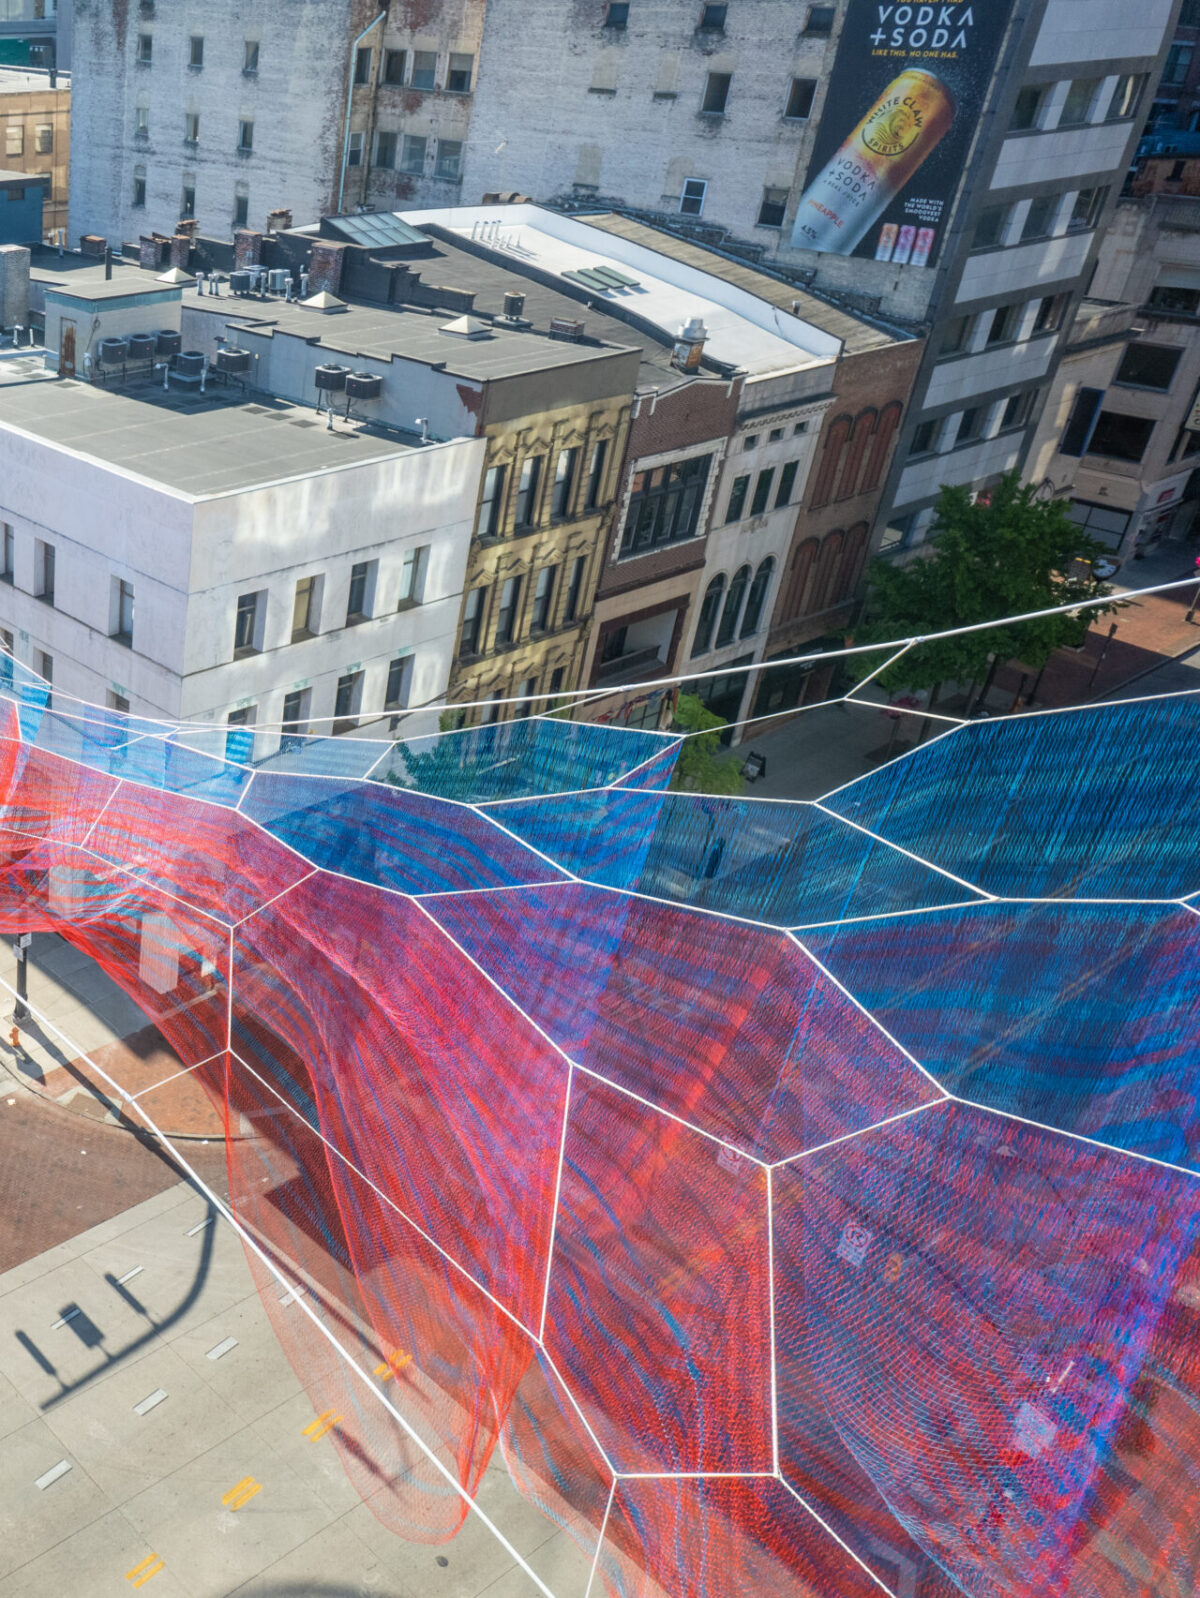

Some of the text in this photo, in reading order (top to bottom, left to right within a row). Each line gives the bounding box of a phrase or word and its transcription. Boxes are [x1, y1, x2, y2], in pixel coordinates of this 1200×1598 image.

[878, 5, 974, 26] VODKA
[869, 27, 967, 48] +SODA
[923, 50, 939, 58] ONE
[866, 96, 923, 128] WHITE CLAW
[868, 138, 904, 153] SPIRITS
[838, 158, 875, 190] VODKA
